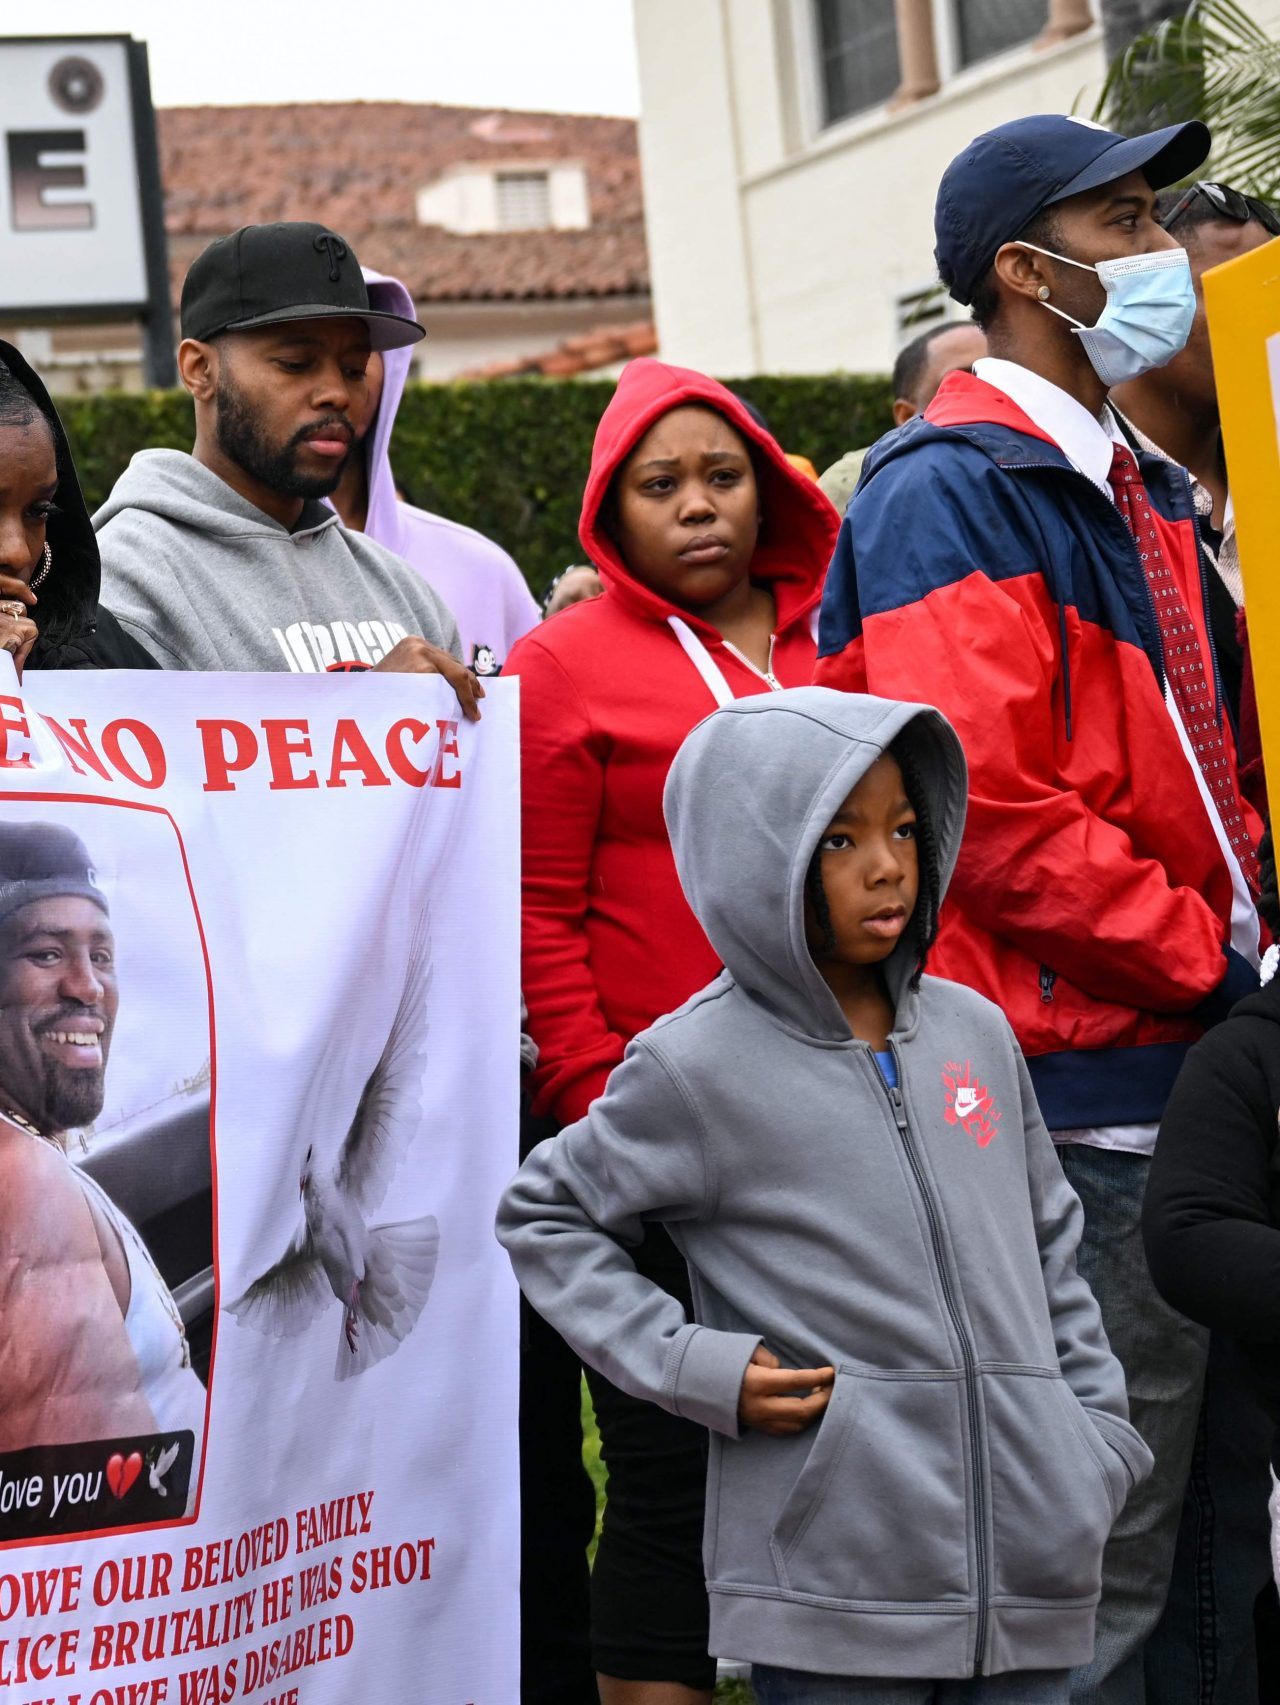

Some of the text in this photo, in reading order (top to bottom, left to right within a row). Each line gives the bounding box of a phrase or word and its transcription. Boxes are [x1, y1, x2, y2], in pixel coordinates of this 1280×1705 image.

[41, 714, 167, 790] NO
[196, 717, 461, 792] PEACE
[49, 1471, 102, 1518] you
[92, 1552, 173, 1607] OUR
[180, 1517, 289, 1593] BELOVED
[295, 1490, 375, 1555] FAMILY
[89, 1587, 256, 1671] BRUTALITY
[261, 1575, 295, 1628] HE
[299, 1556, 343, 1612] WAS
[350, 1538, 436, 1595] SHOT
[177, 1658, 239, 1705] WAS
[242, 1613, 355, 1696] DISABLED
